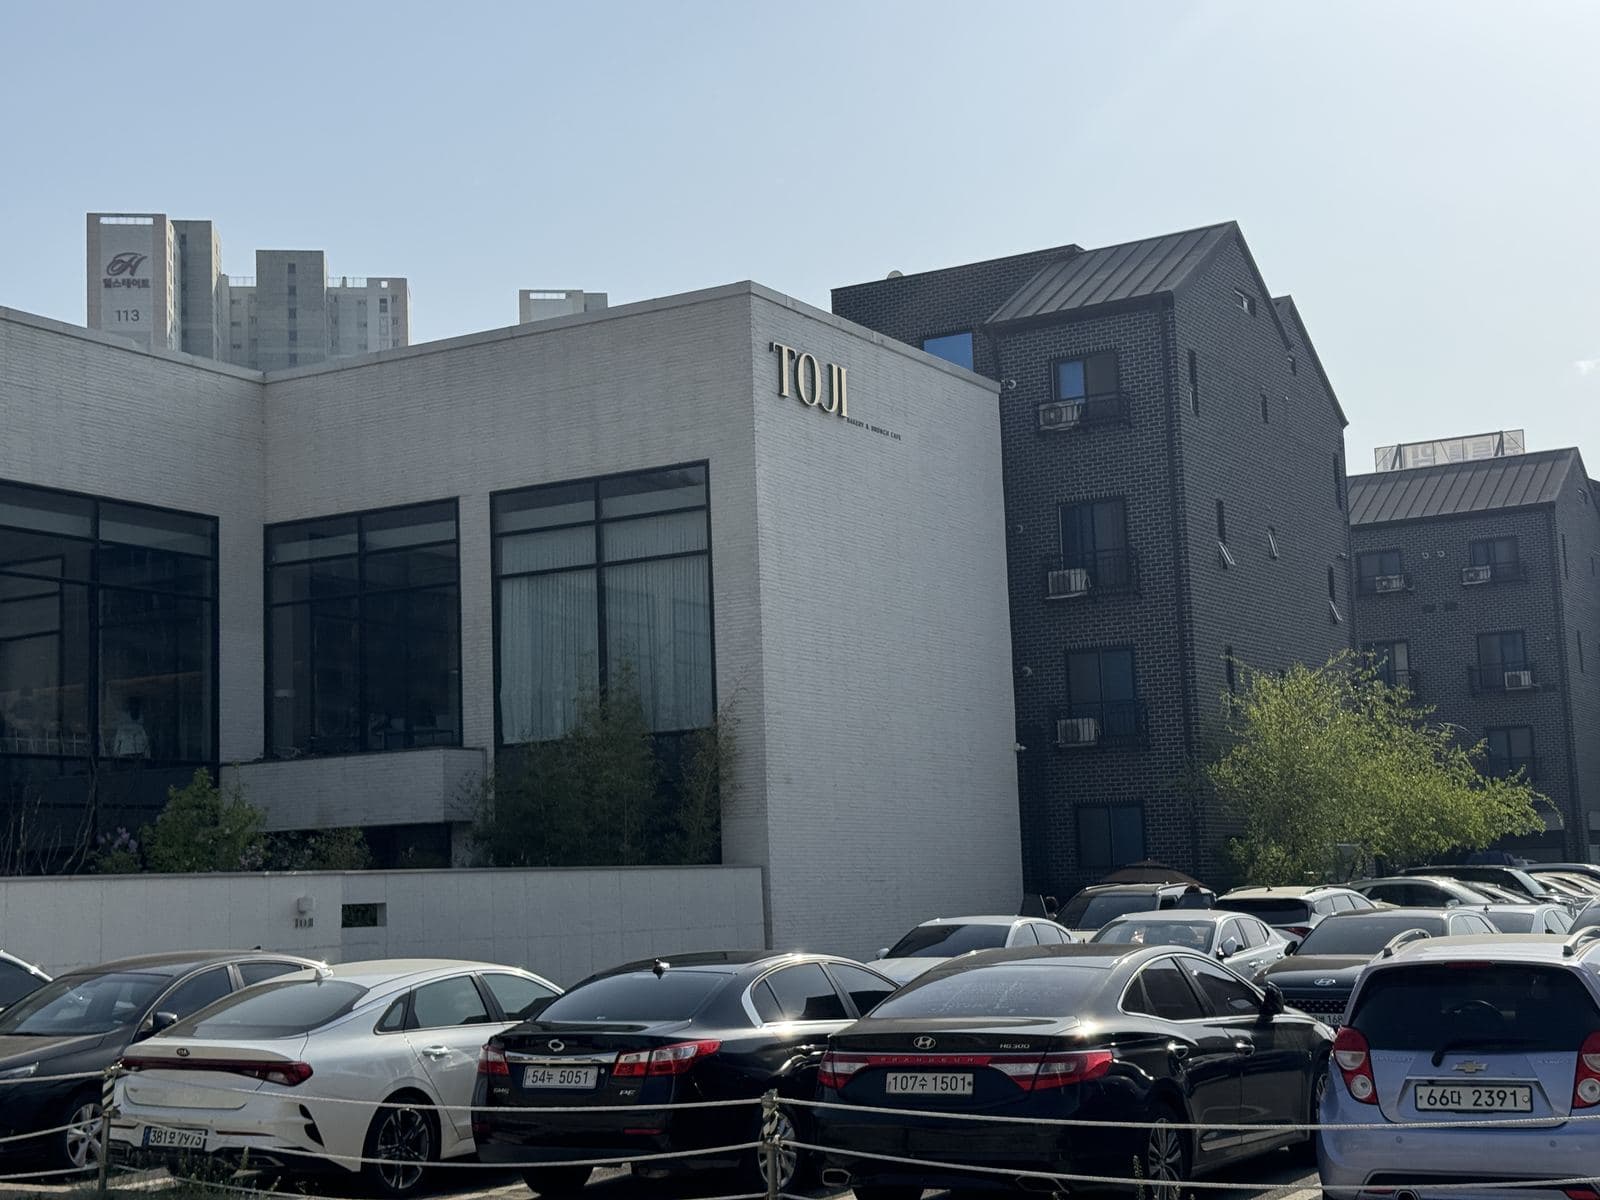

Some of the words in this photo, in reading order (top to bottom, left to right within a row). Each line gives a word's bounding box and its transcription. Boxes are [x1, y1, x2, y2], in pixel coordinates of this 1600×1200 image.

[115, 309, 140, 322] 113
[769, 342, 848, 417] TOJI
[558, 1070, 589, 1084] 5051
[892, 1075, 926, 1091] 107수
[932, 1075, 966, 1091] 1501
[1427, 1089, 1461, 1107] 66다
[1472, 1089, 1517, 1107] 2391
